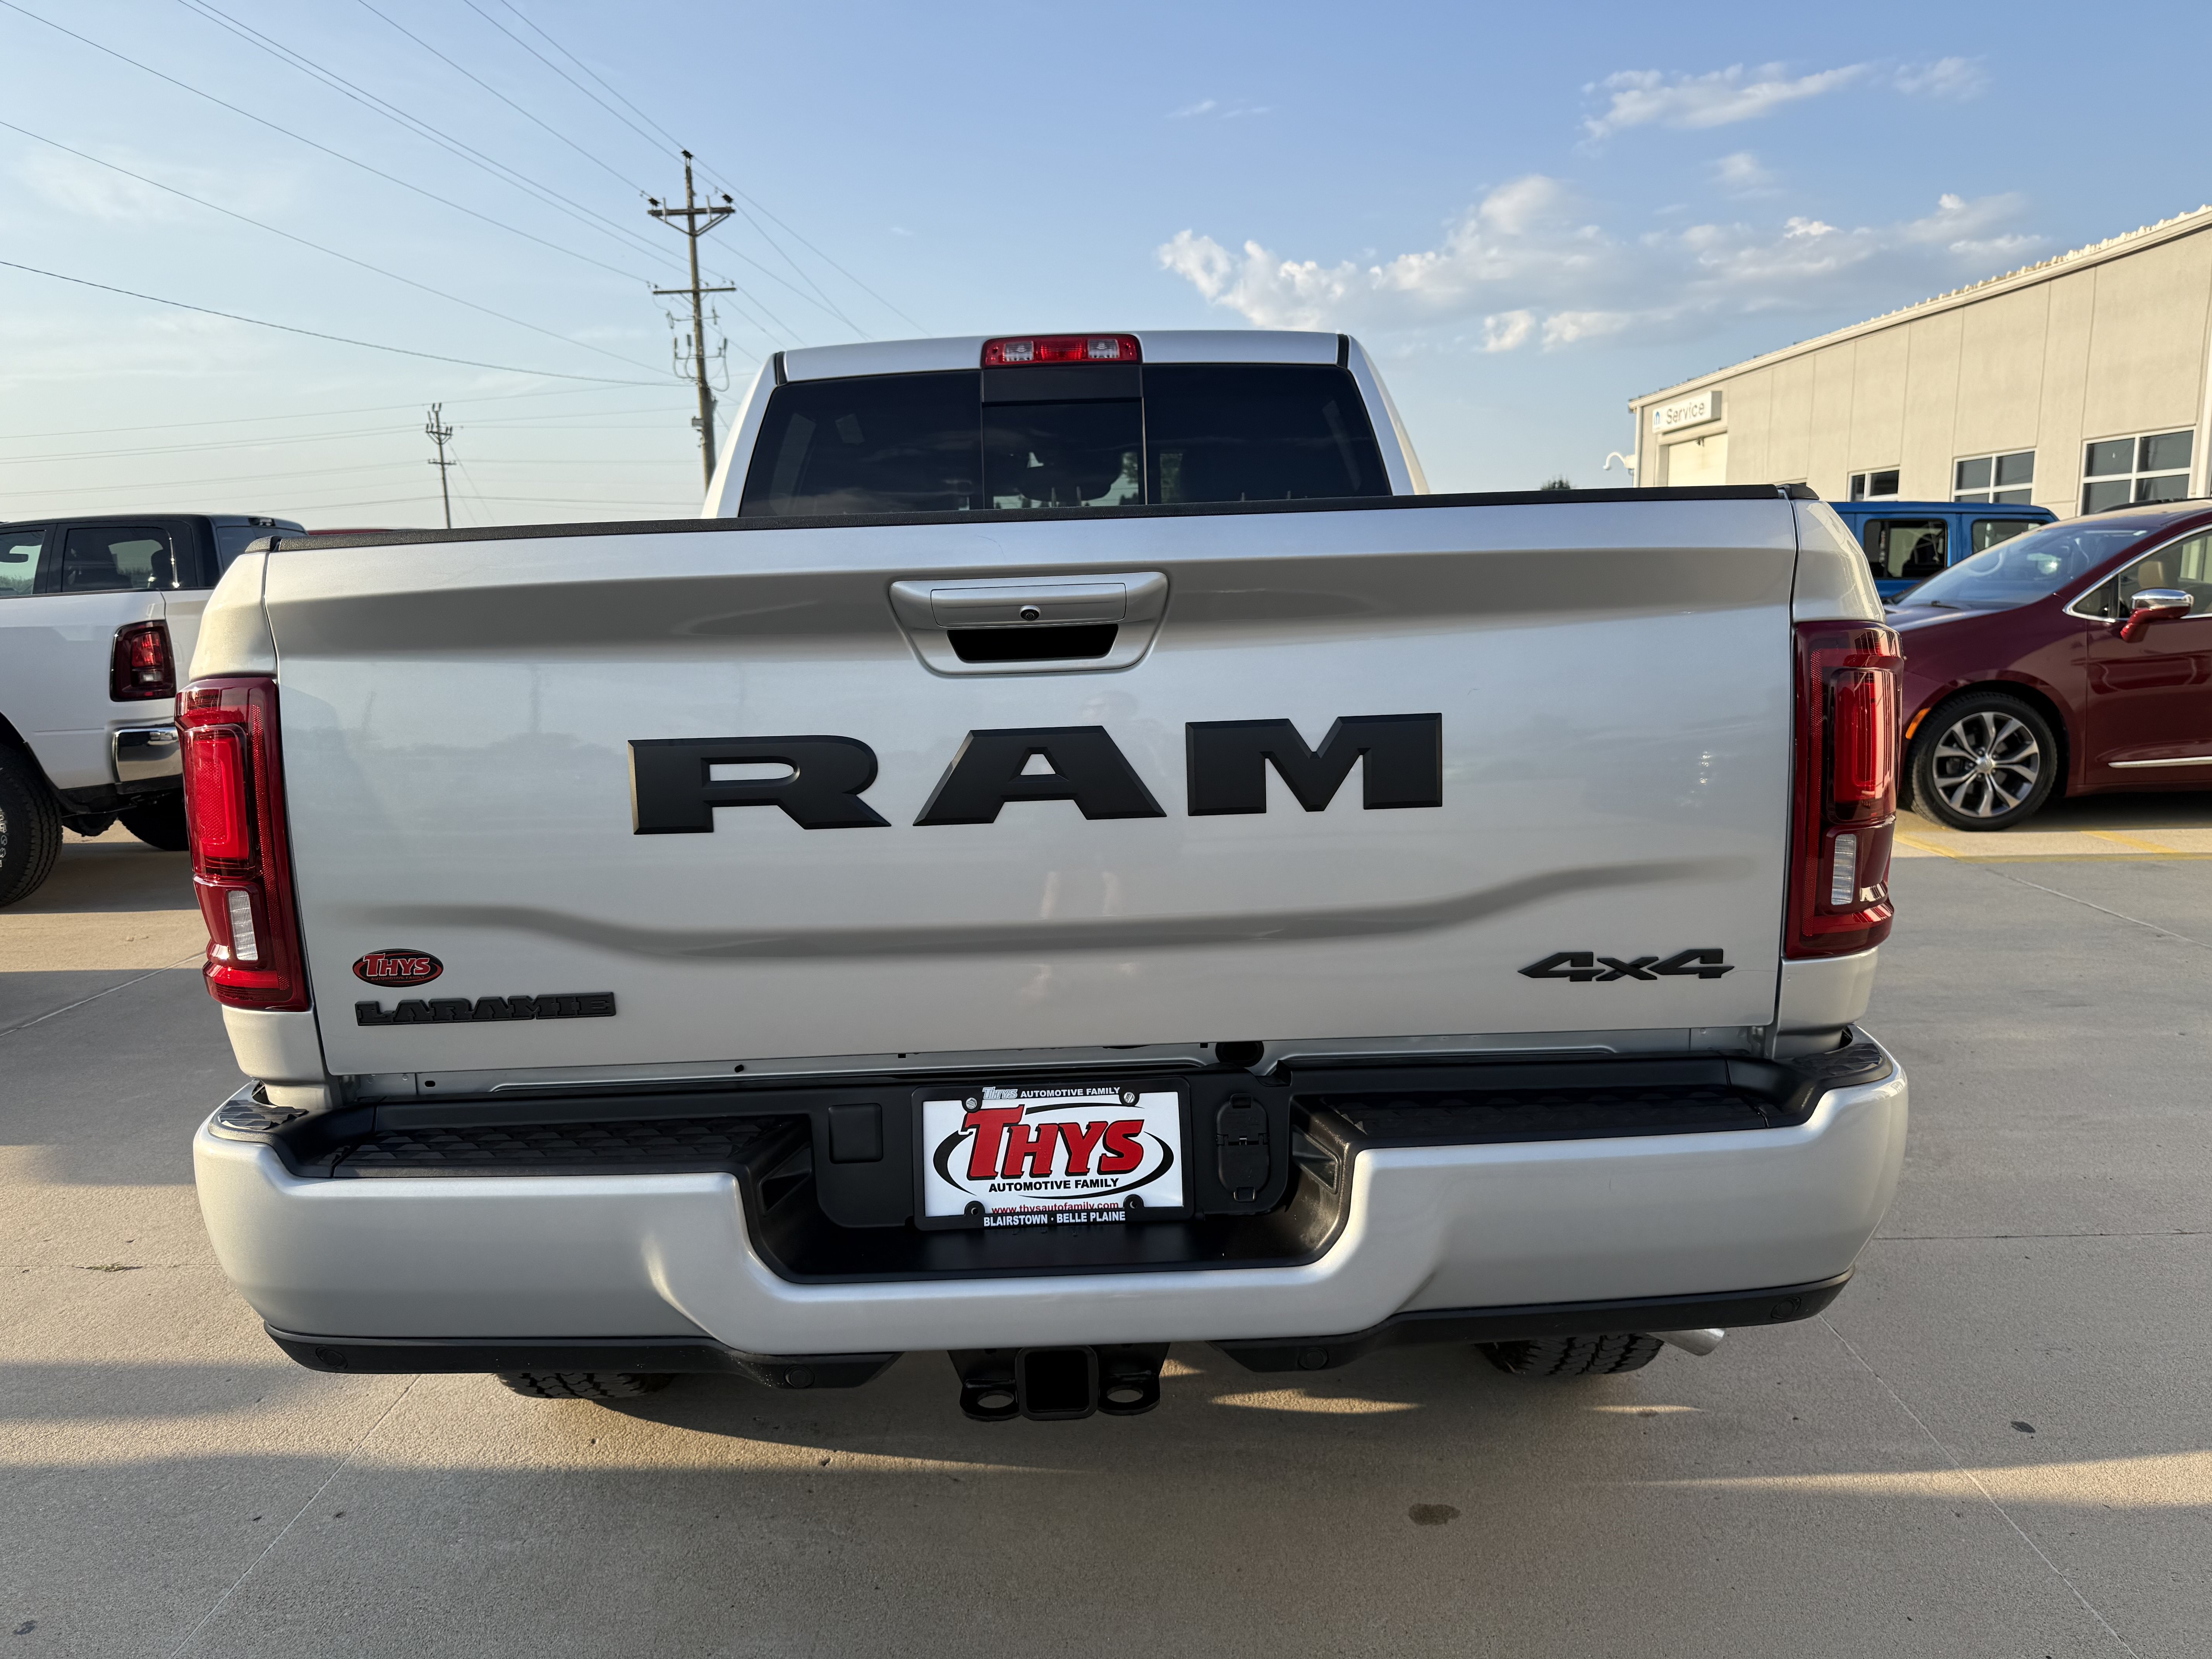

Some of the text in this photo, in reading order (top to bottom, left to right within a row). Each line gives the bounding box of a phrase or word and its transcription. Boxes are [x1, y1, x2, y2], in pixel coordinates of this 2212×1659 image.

[1666, 402, 1705, 424] Service
[628, 713, 1443, 835] RAM
[363, 953, 431, 977] THYS
[1517, 948, 1735, 982] 4x4
[355, 992, 616, 1026] LARAMIE
[982, 1086, 1120, 1099] THYS AUTOMOTIVE FAMILY
[961, 1104, 1144, 1181] THYS
[989, 1178, 1119, 1192] AUTOMOTIVE FAMILY
[984, 1211, 1125, 1227] BLAIRSTOWN BELLE PLAINE
